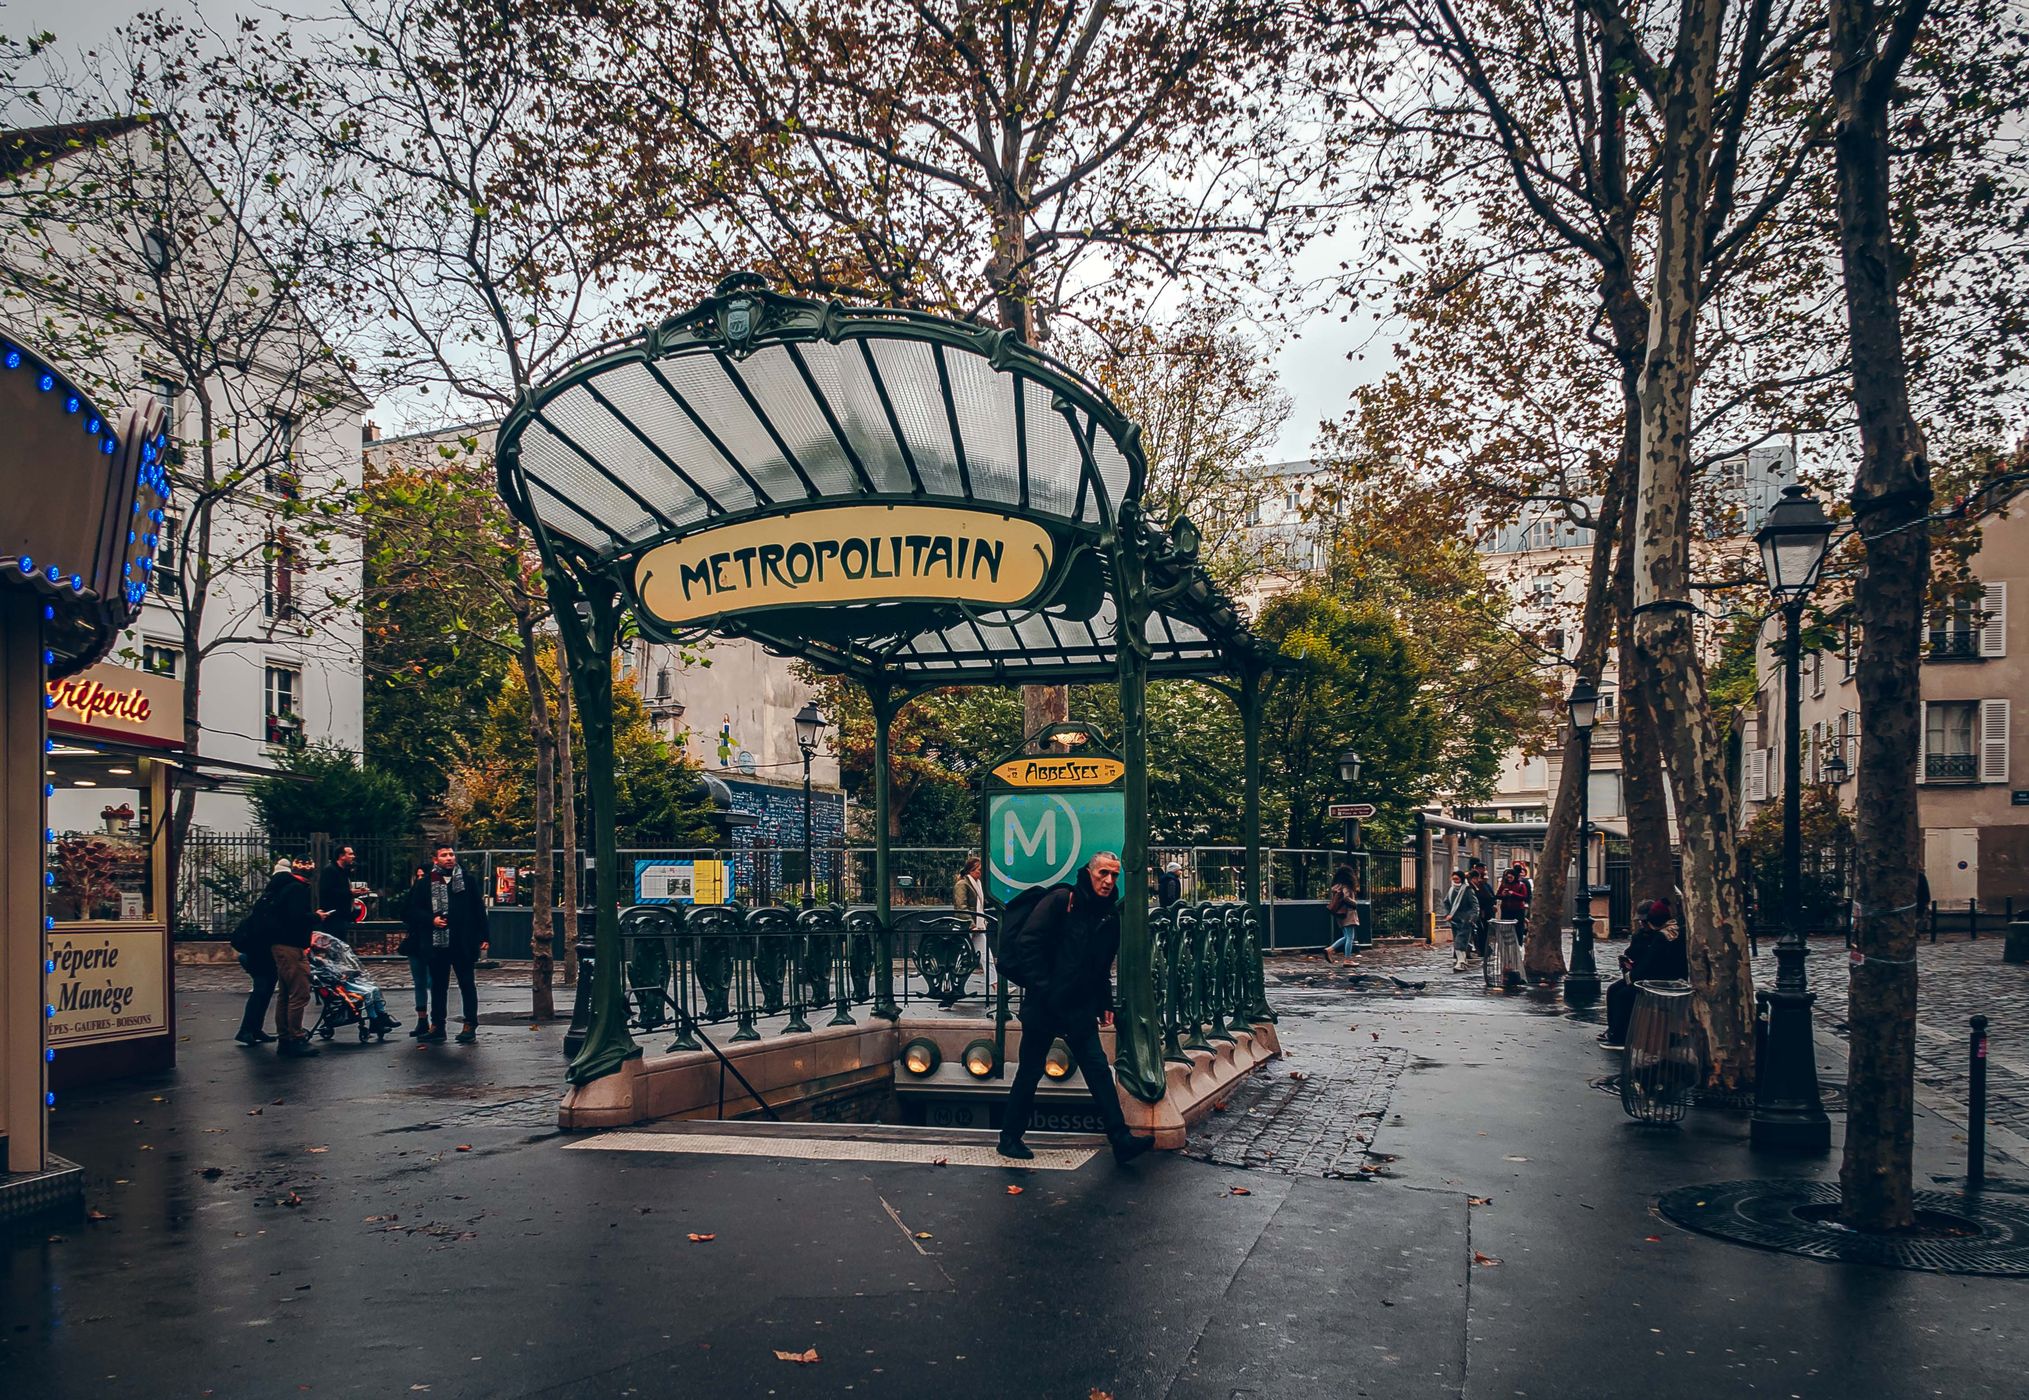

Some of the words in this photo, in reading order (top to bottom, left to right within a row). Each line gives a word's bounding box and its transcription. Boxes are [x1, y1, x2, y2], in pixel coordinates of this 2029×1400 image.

[680, 535, 1004, 601] METROPOLITAIN
[1004, 809, 1056, 866] M
[48, 940, 119, 979] rêperie
[57, 979, 133, 1015] Manège
[48, 1022, 69, 1036] ÊPES
[116, 1014, 152, 1028] BOISSONS
[1027, 1109, 1105, 1130] besses
